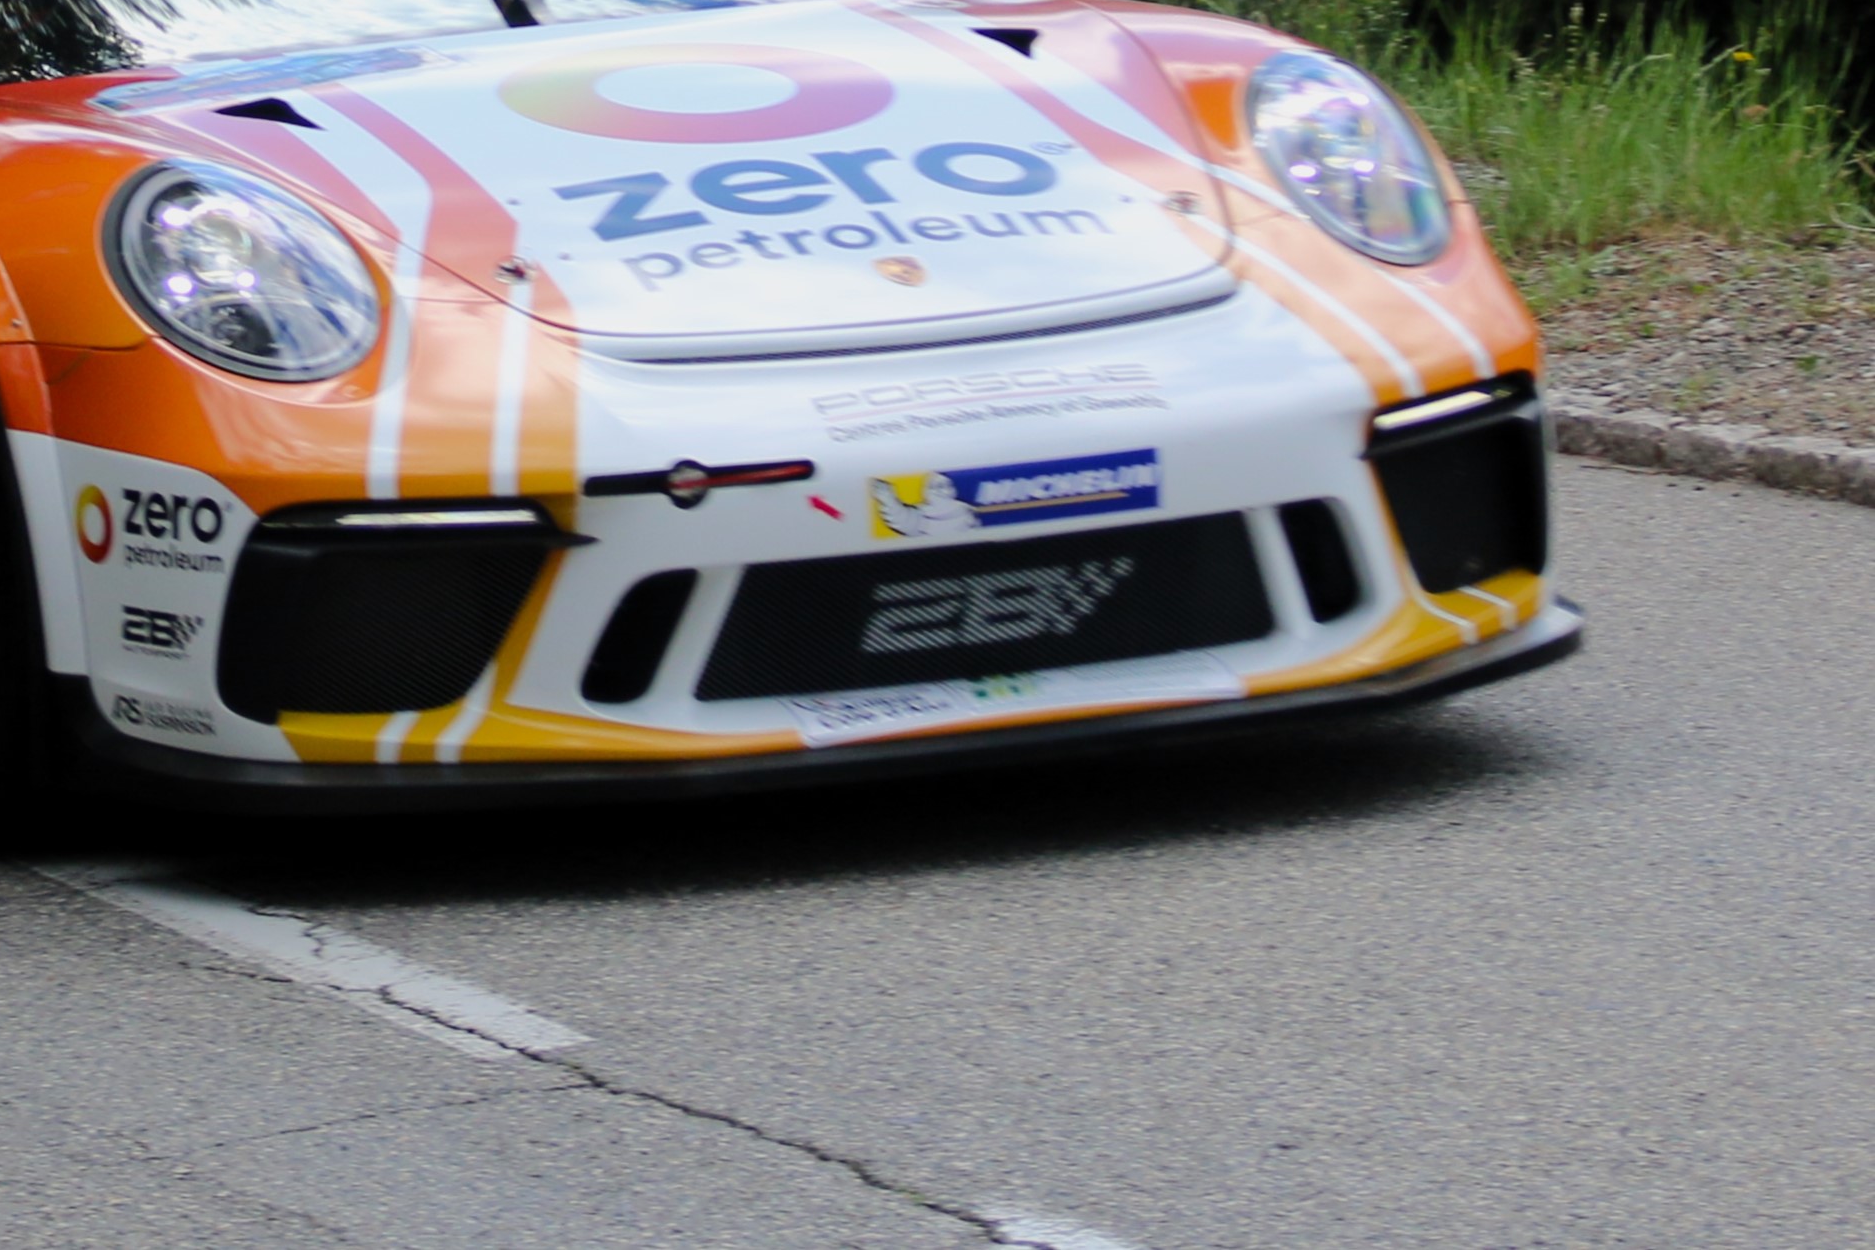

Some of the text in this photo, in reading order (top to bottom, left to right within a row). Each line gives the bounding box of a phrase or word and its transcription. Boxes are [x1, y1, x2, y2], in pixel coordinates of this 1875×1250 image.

[553, 139, 1059, 243] zero
[622, 200, 1114, 293] petroleum
[812, 362, 1155, 416] PORSCHE
[976, 462, 1162, 504] MICHELIN
[122, 488, 223, 543] zero
[124, 543, 224, 574] petroleum
